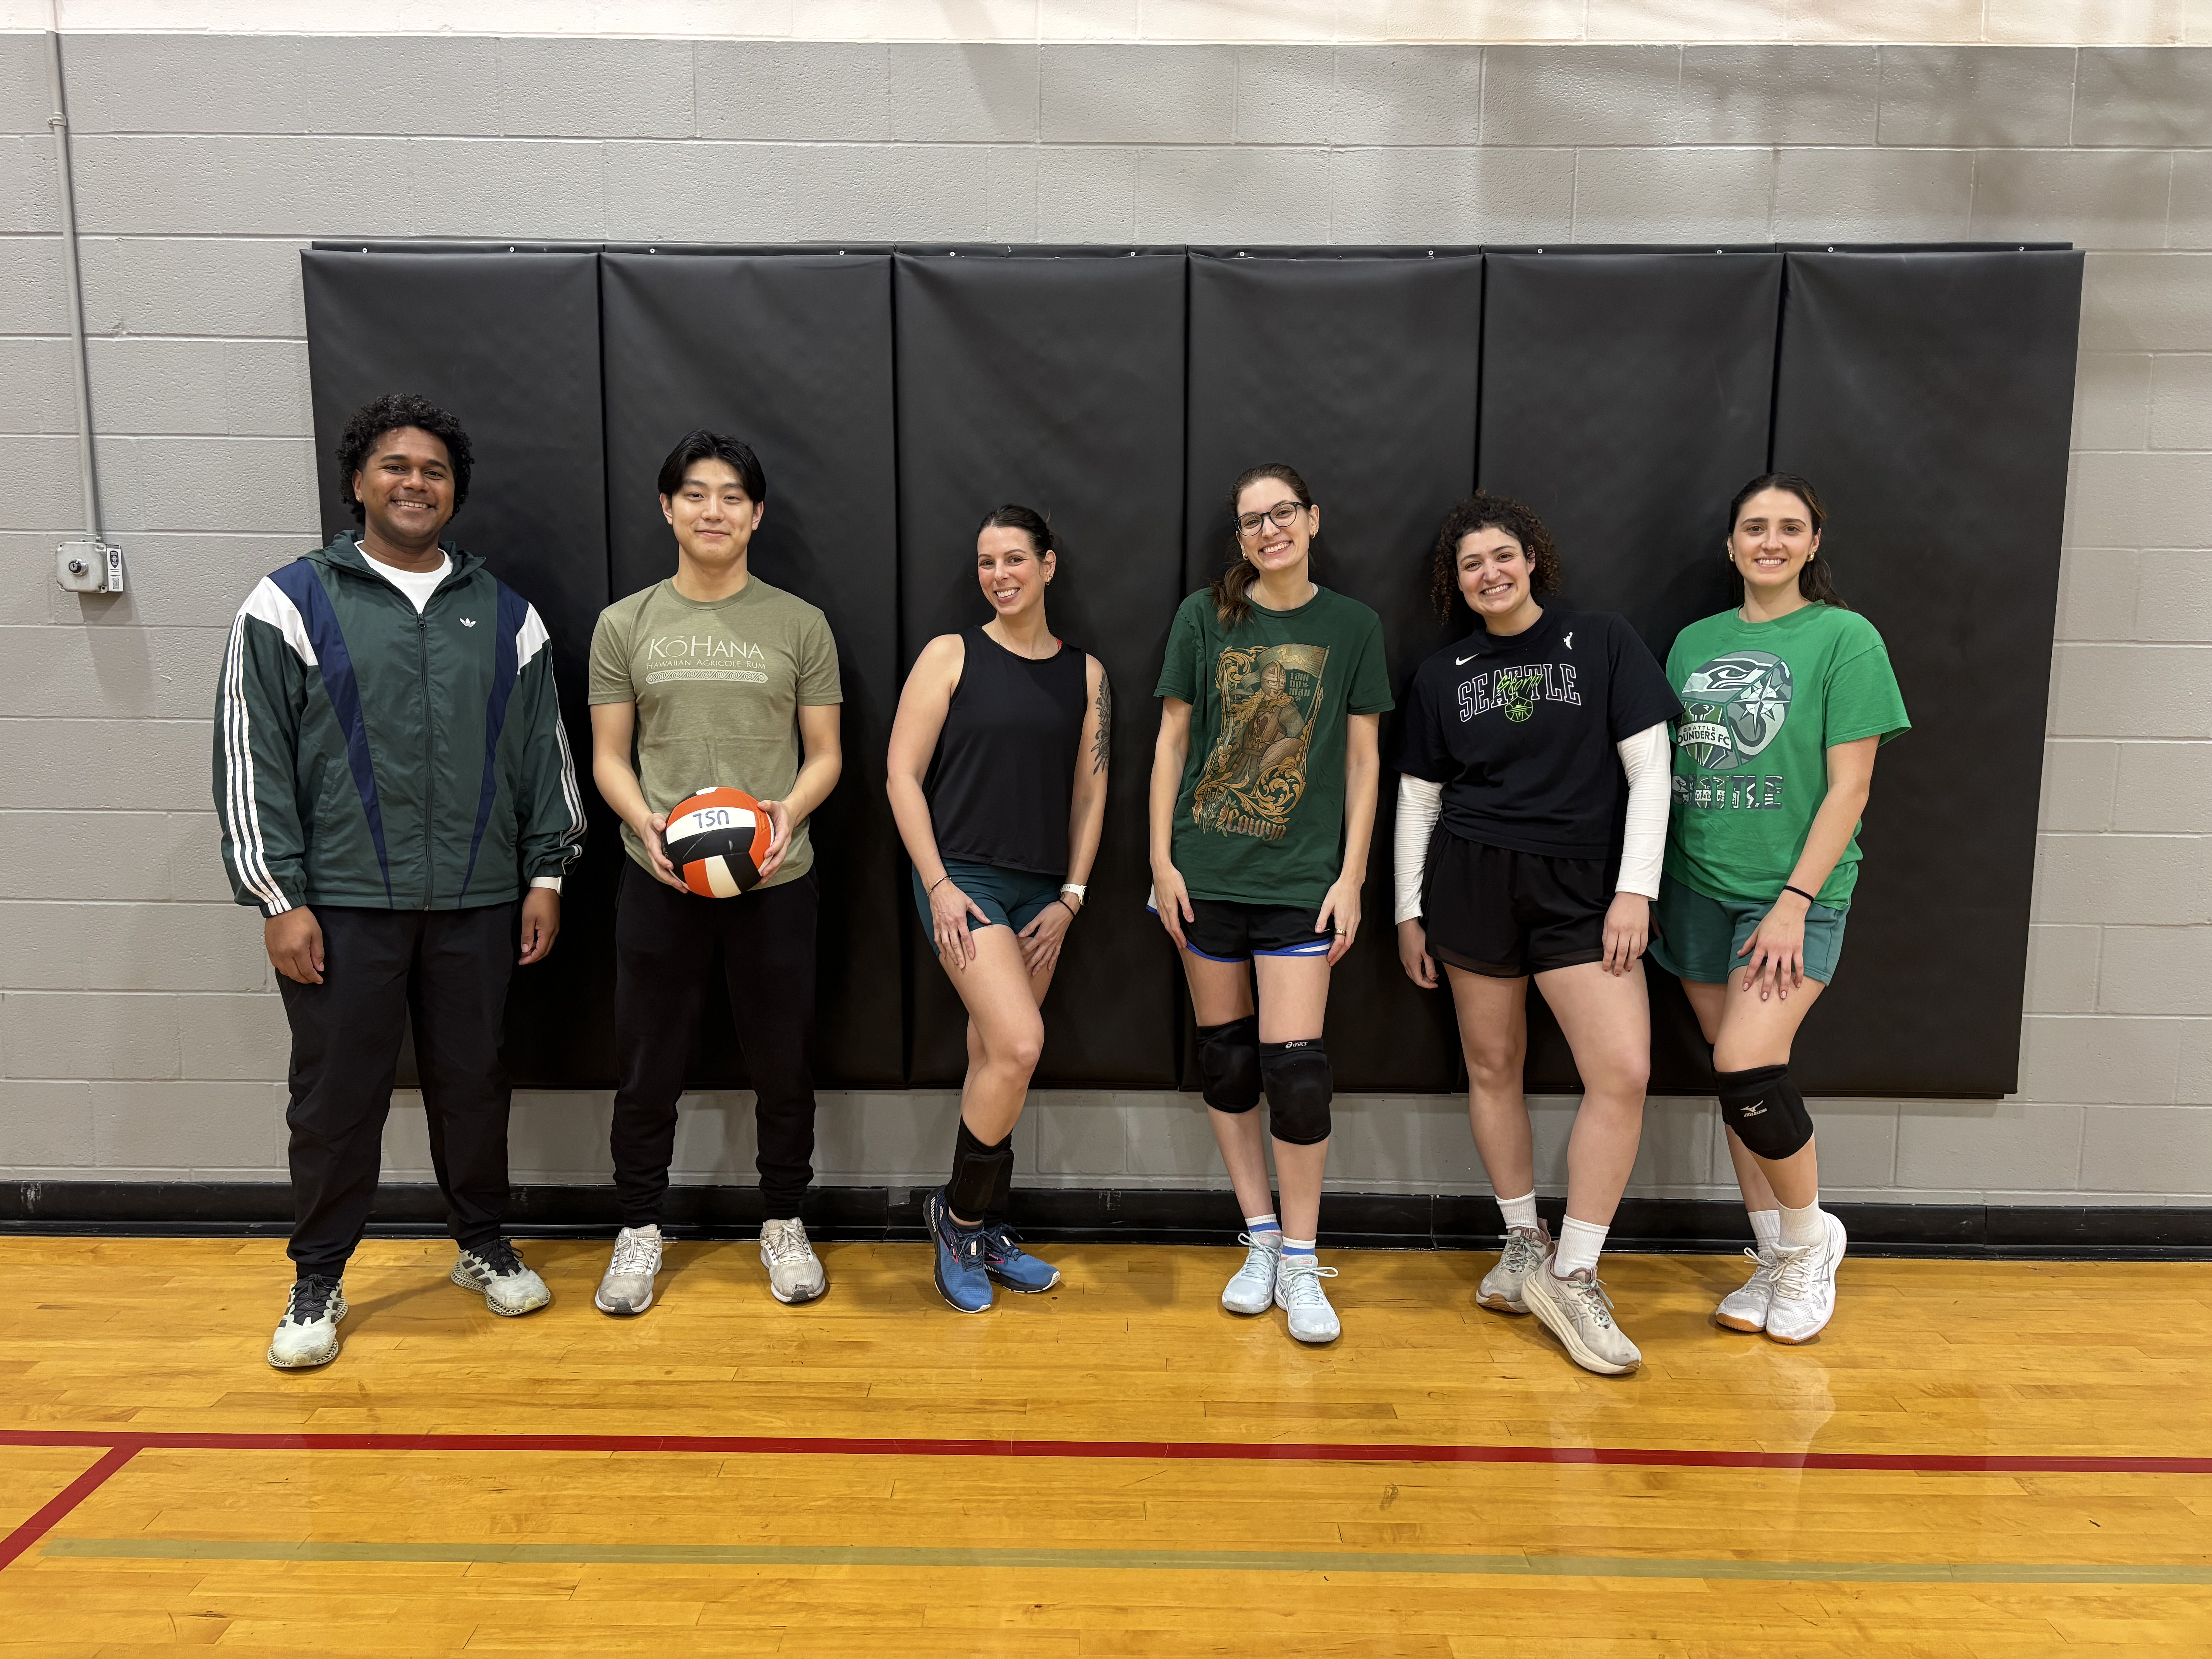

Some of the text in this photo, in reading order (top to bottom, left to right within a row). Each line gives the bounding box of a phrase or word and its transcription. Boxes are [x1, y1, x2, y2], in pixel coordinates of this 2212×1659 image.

[647, 659, 766, 670] HAWAIIAN AGRICOLE RUM
[1295, 673, 1309, 682] am
[1290, 680, 1302, 688] no
[1490, 672, 1544, 701] Storm
[1288, 688, 1310, 697] man
[1458, 663, 1582, 723] SEATTLE
[1677, 730, 1730, 746] OUNDERS FC
